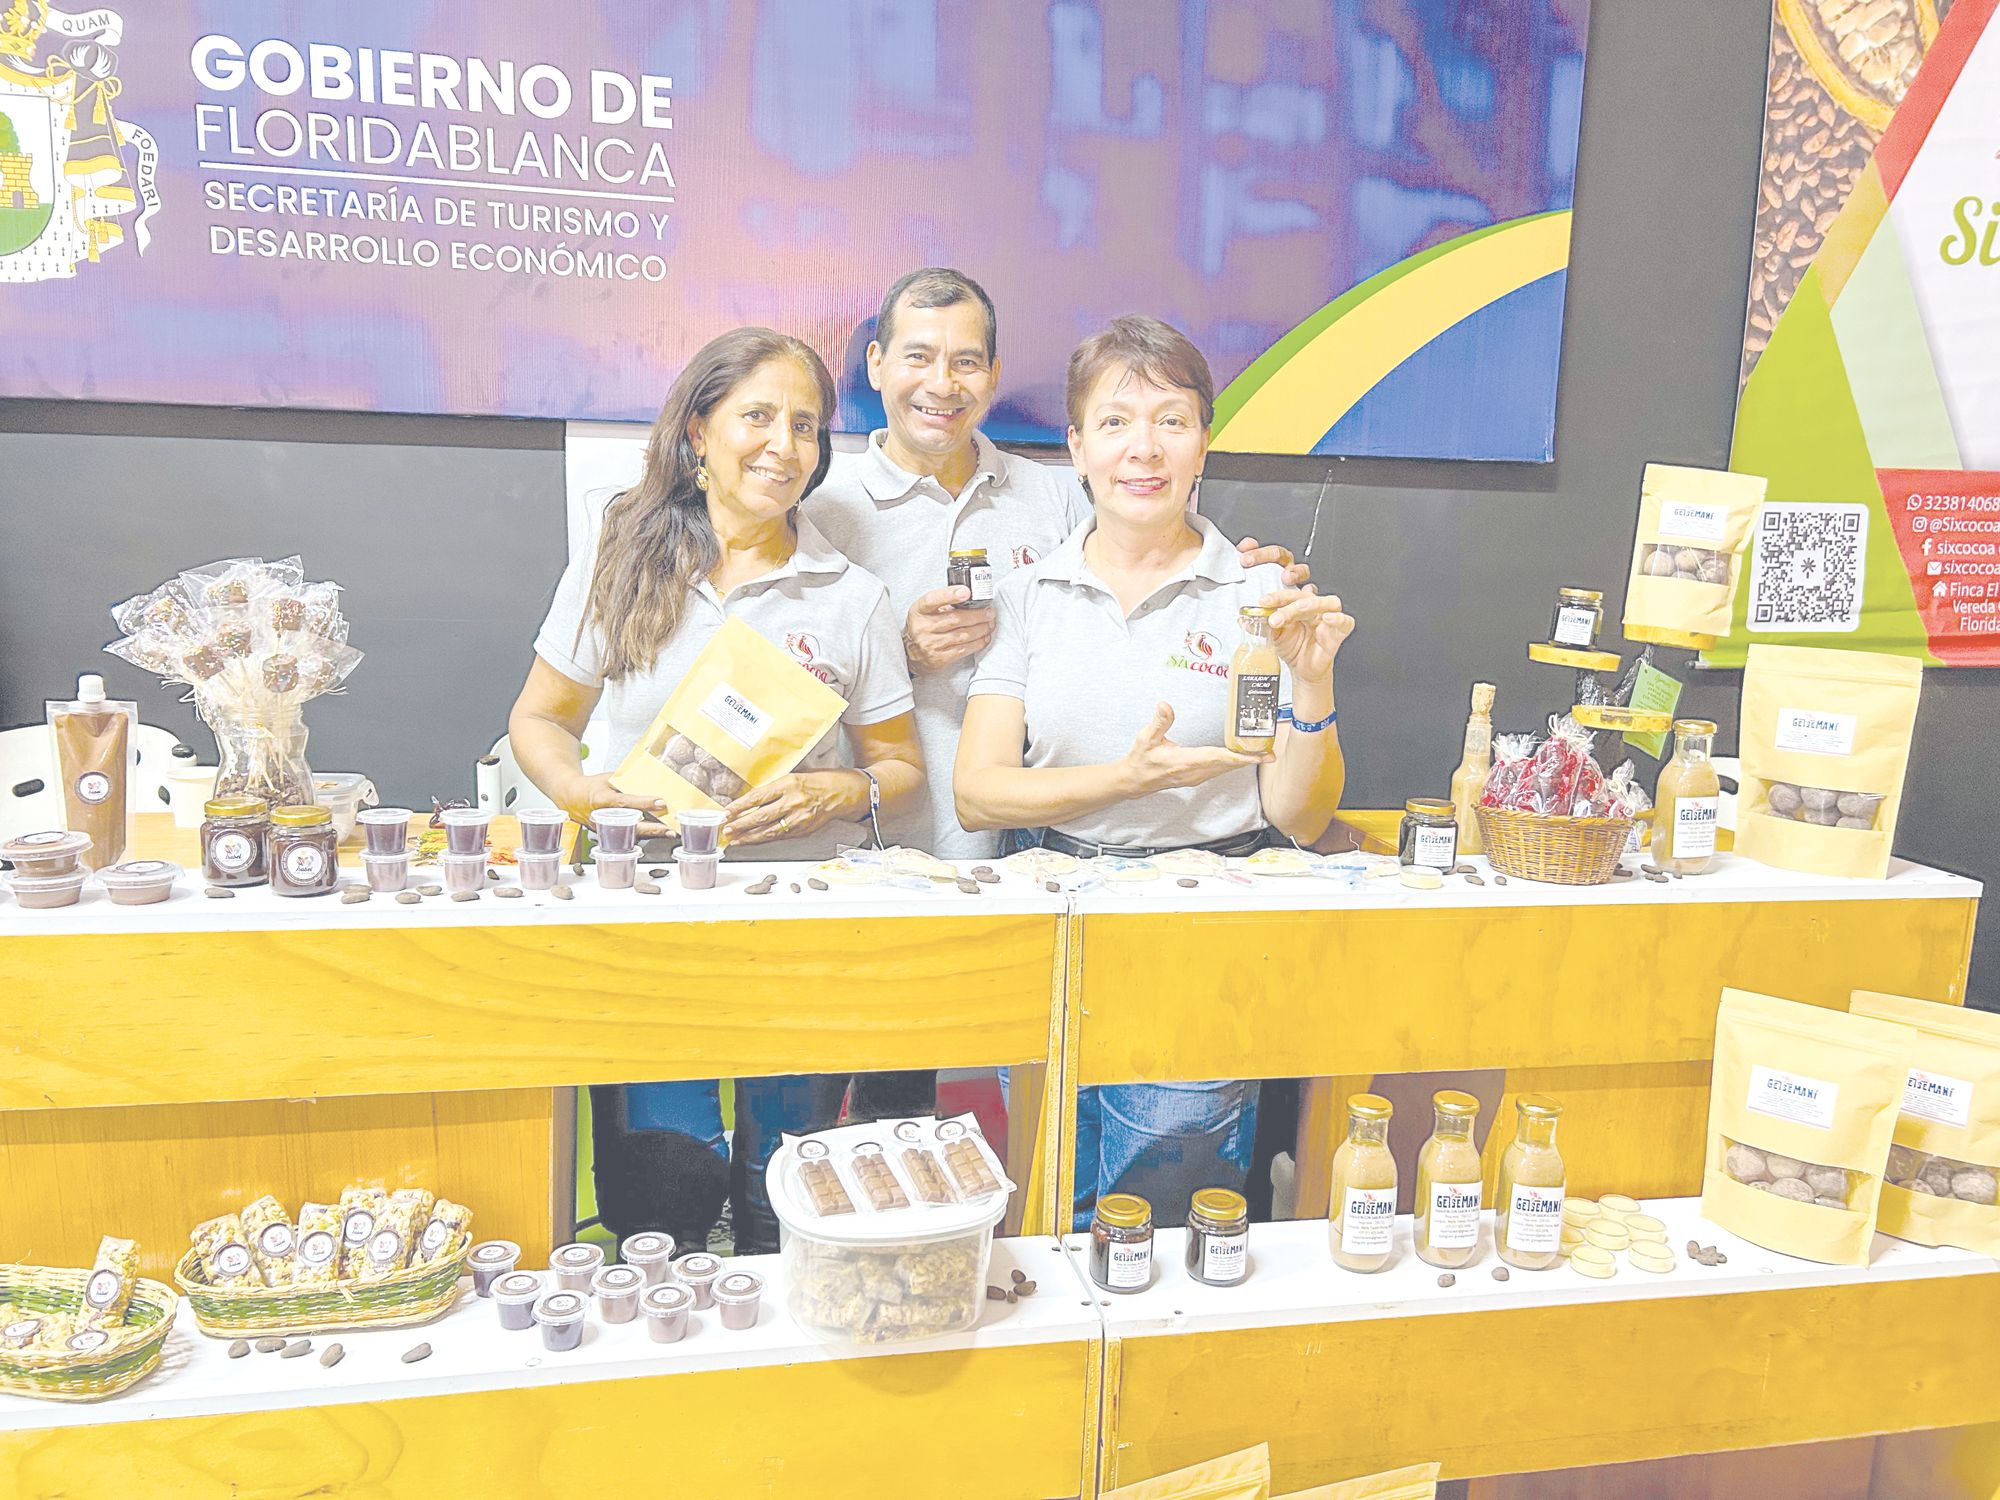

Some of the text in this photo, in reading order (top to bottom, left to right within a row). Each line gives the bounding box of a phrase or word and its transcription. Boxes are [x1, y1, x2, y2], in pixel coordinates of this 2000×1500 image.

[62, 13, 110, 32] QUAM
[190, 34, 673, 129] GOBIERNO DE
[195, 103, 676, 188] FLORIDABLANCA
[131, 128, 158, 207] FOEDARI
[204, 180, 669, 241] SECRETARÍA DE TURISMO Y
[210, 225, 668, 282] DESARROLLO ECONÓMICO
[1924, 495, 2000, 511] 323814068
[1937, 540, 1995, 555] sixcocoa
[1950, 581, 1999, 597] Finca El
[1953, 599, 1996, 613] Vereda
